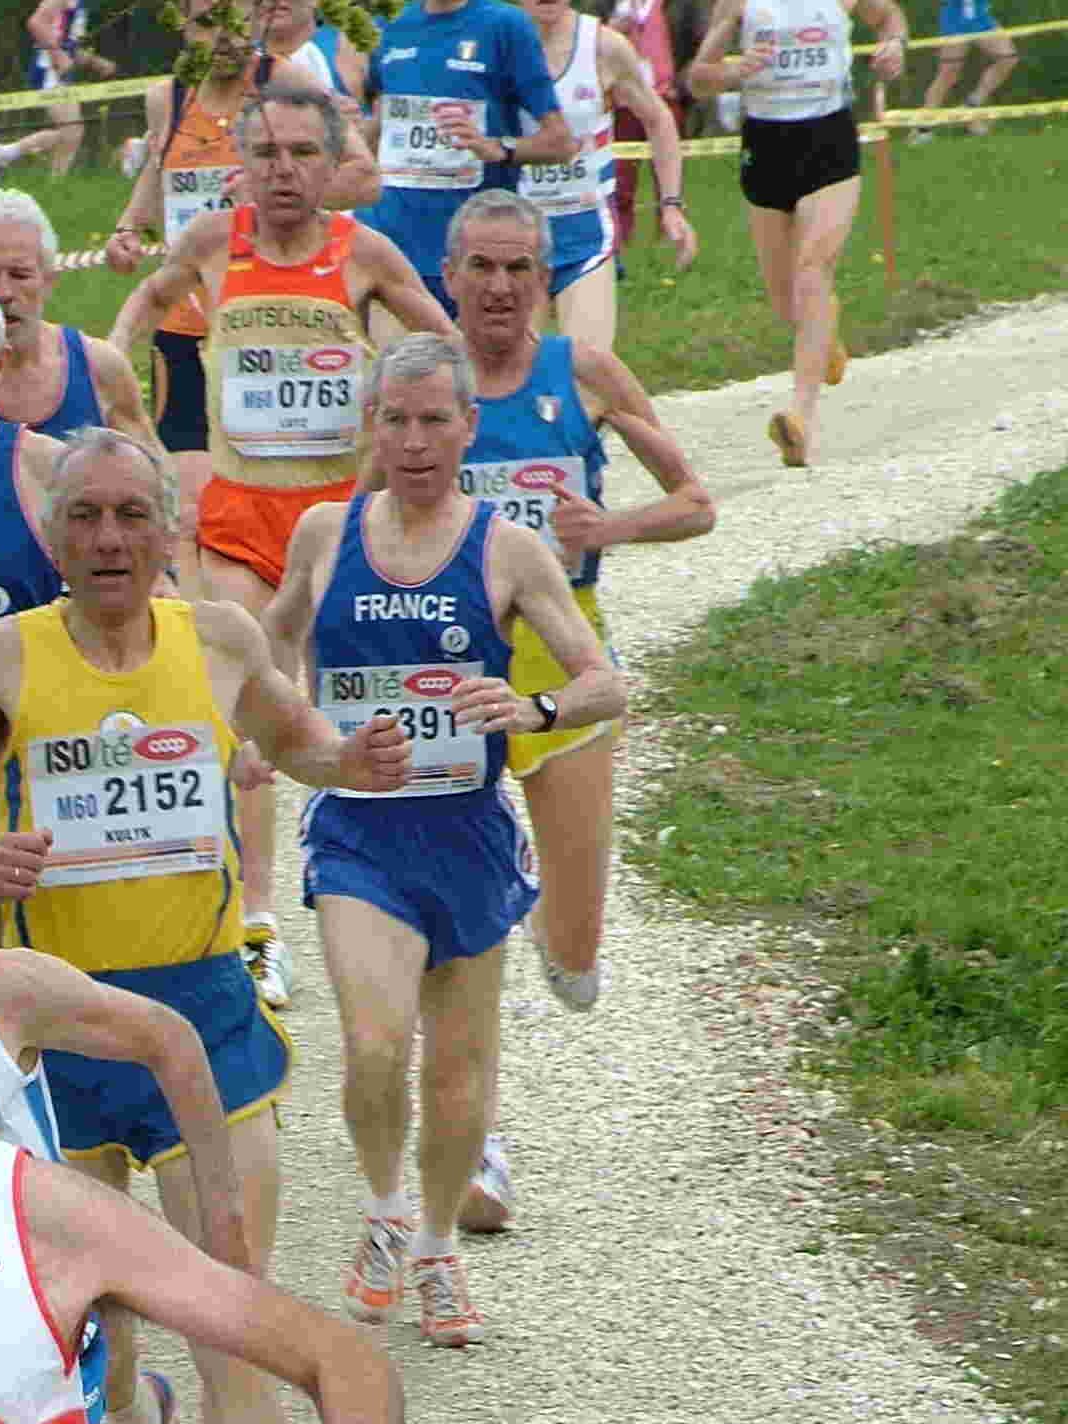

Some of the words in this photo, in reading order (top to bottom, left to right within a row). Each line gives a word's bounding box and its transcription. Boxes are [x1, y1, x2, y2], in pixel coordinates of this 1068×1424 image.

[278, 378, 350, 409] 0763
[354, 593, 457, 622] FRANCE
[57, 793, 99, 820] M60
[104, 770, 204, 816] 2152
